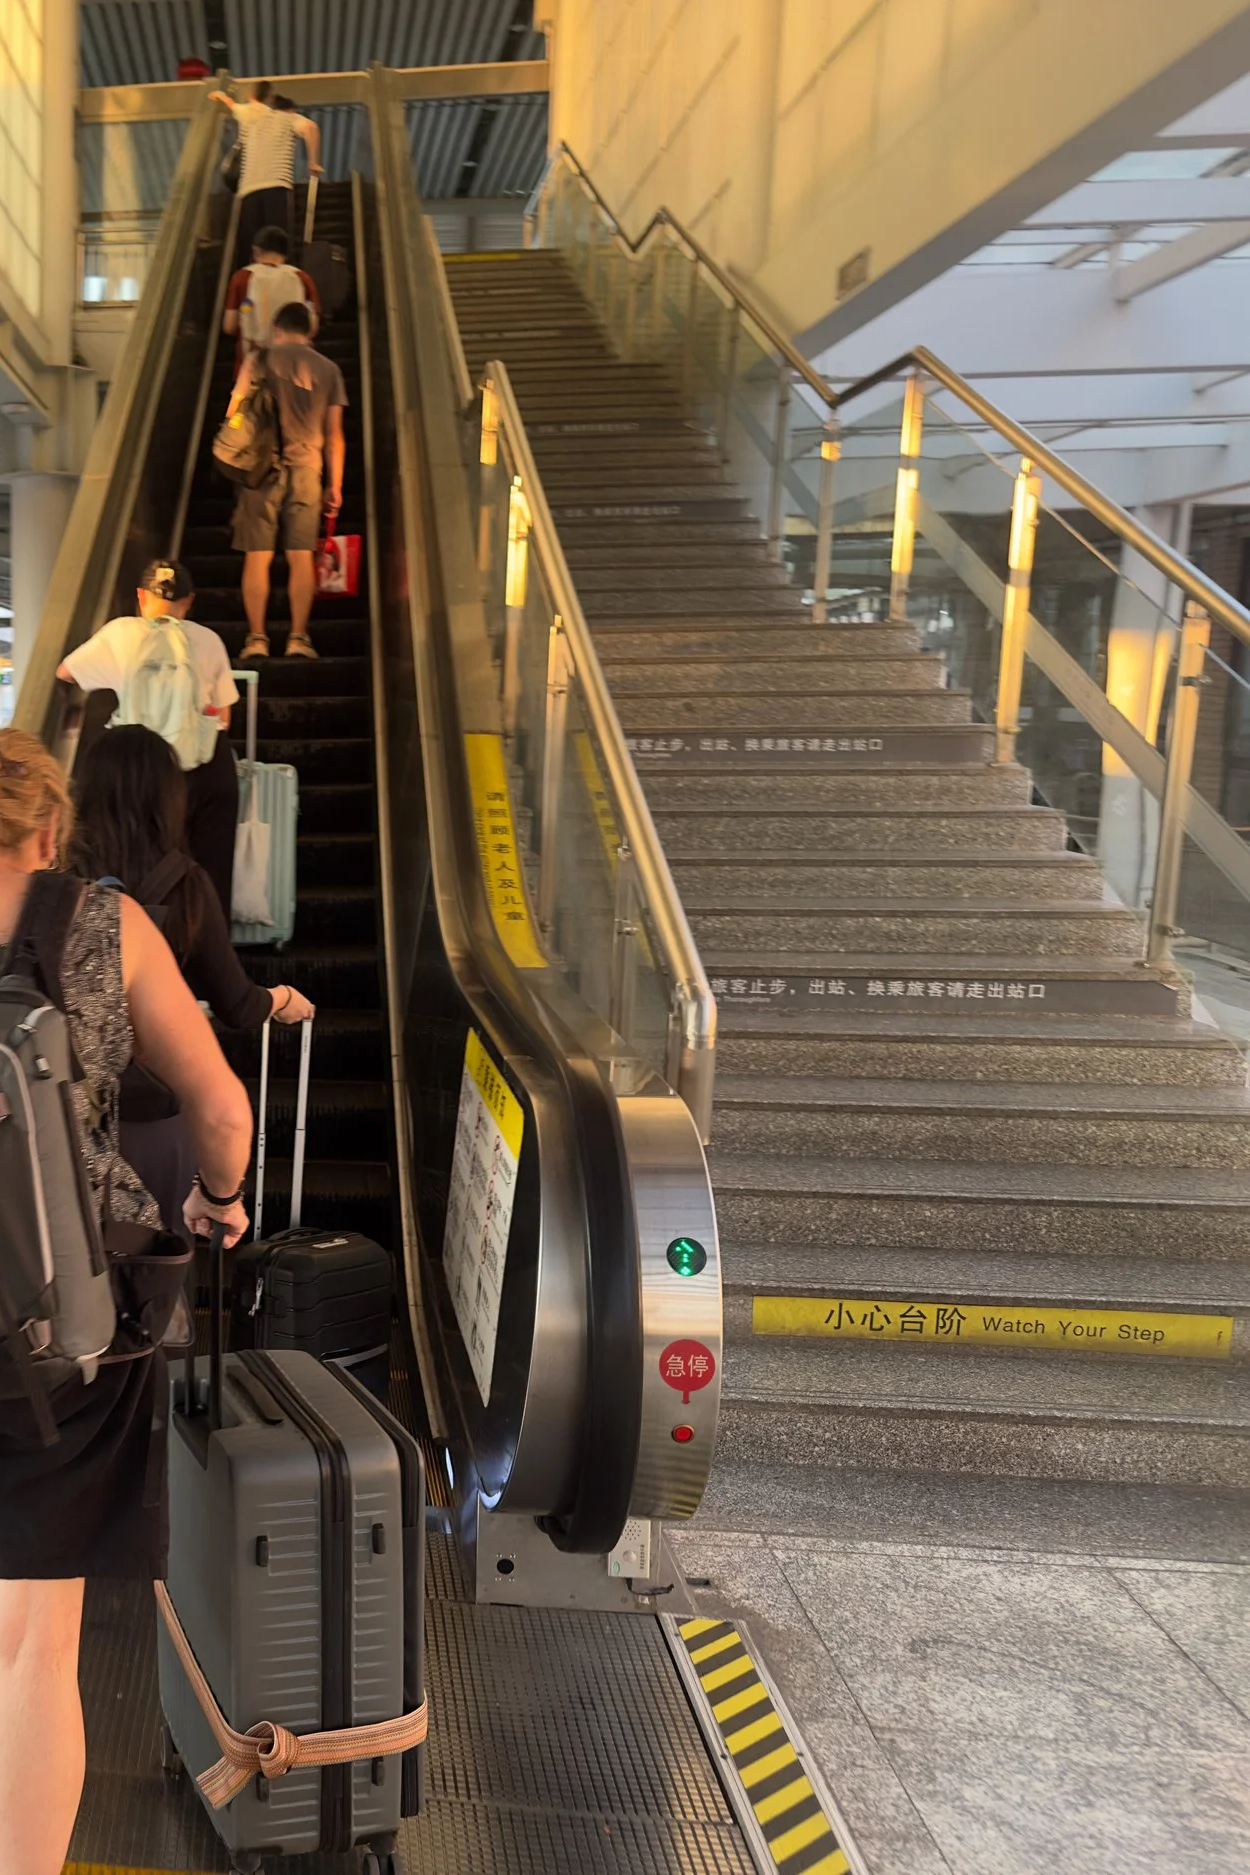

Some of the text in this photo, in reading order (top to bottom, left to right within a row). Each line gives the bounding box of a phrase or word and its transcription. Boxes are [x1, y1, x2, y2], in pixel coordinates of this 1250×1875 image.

[823, 1302, 1166, 1345] 小心台阶 Watch Your Step
[665, 1353, 709, 1378] 急停
